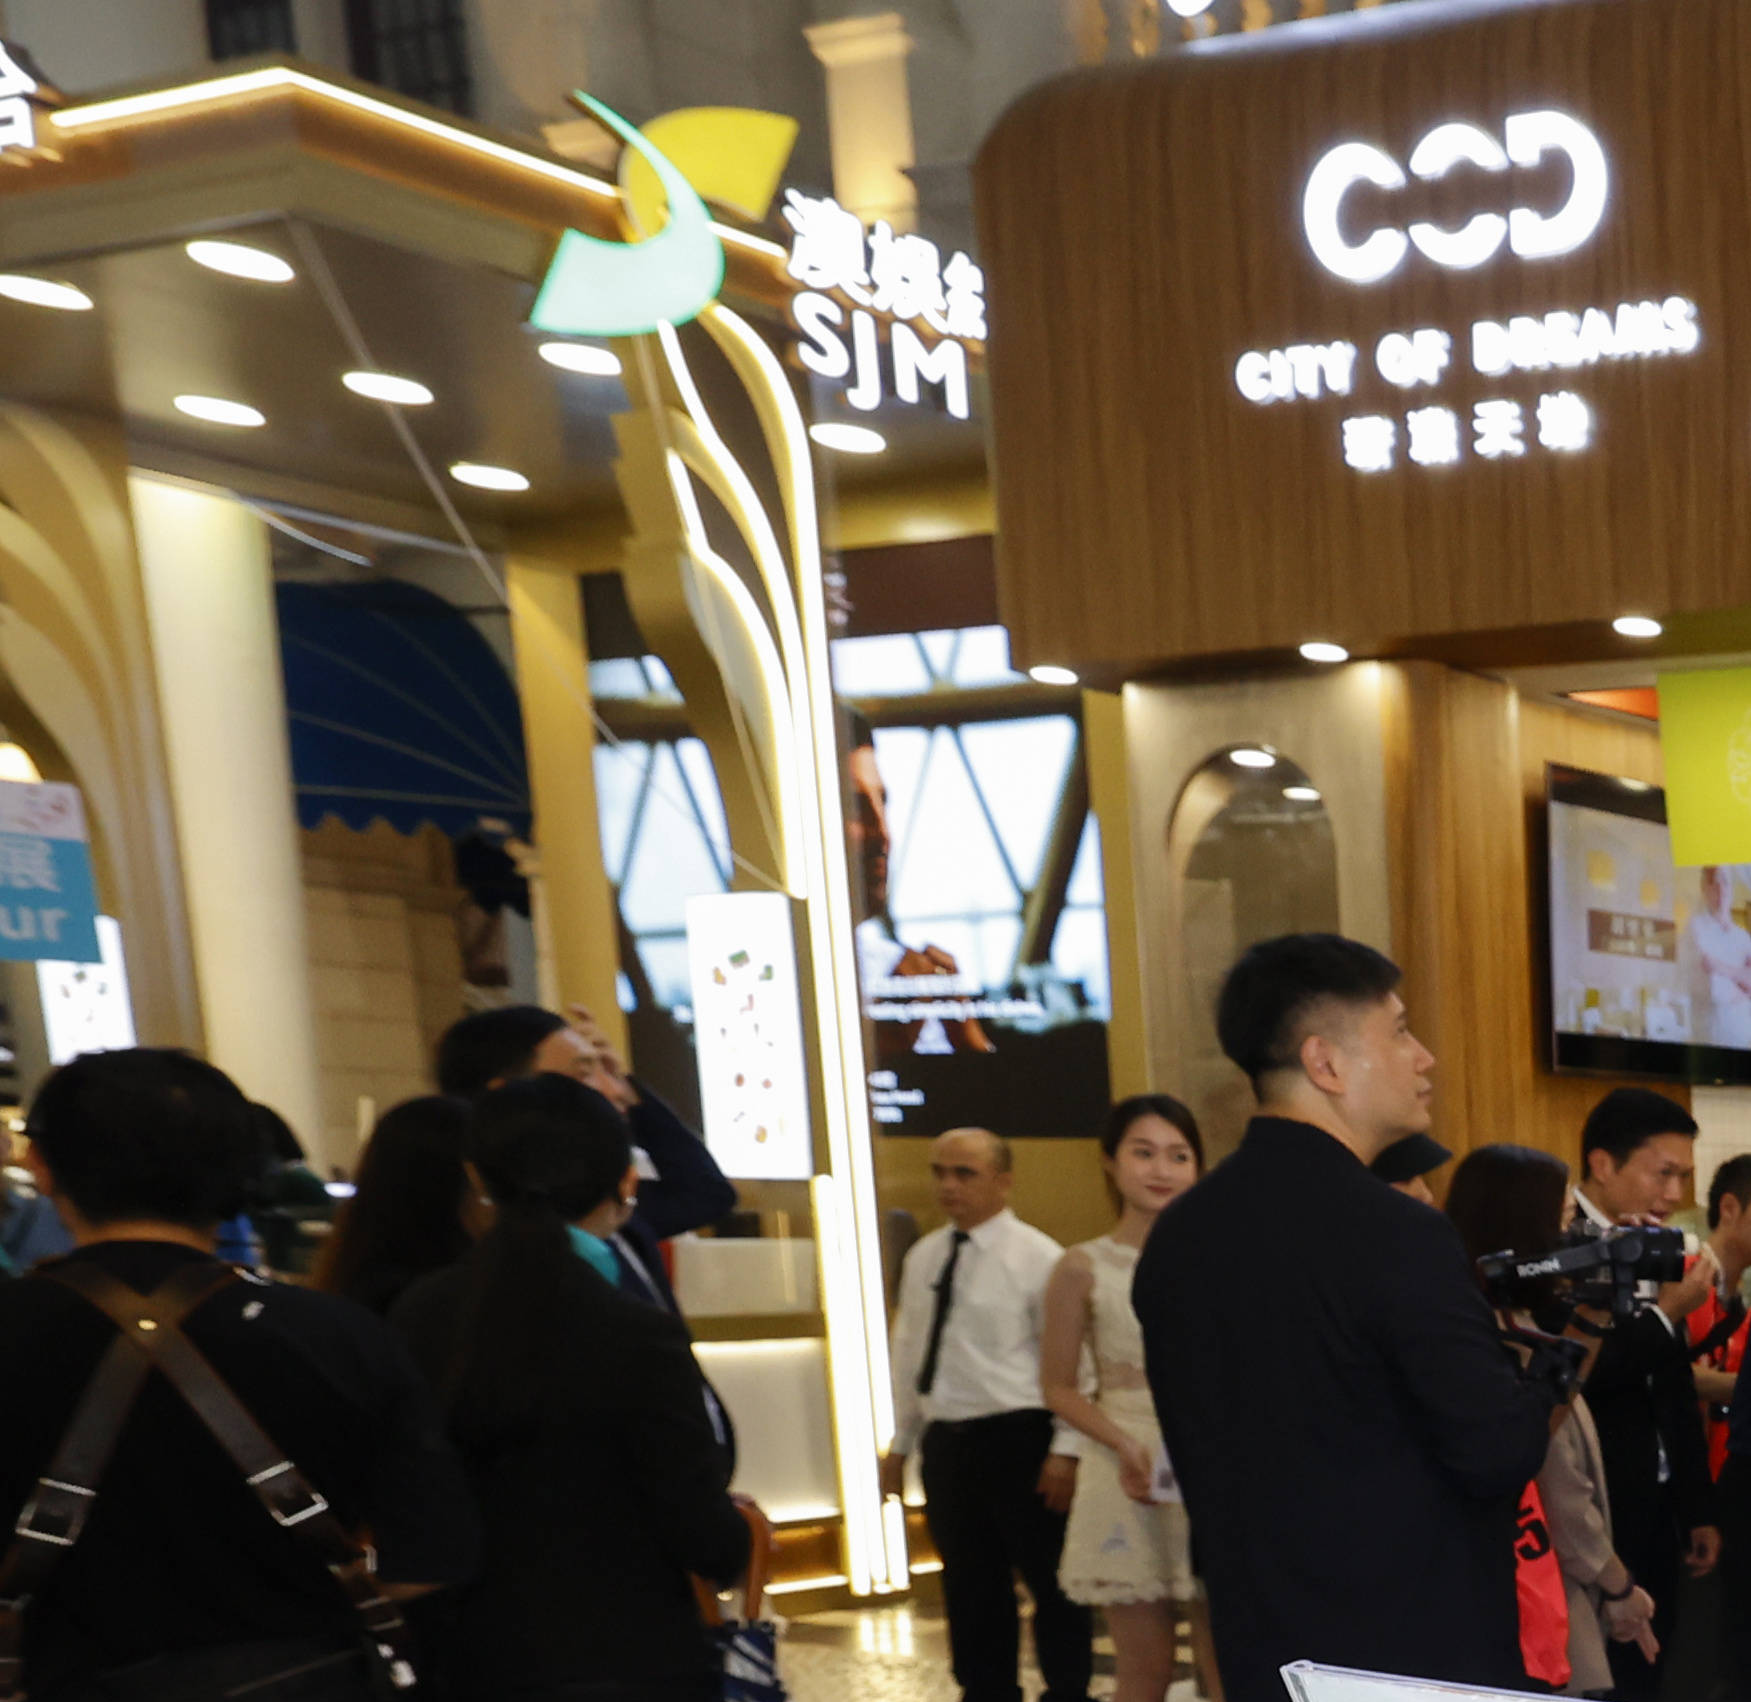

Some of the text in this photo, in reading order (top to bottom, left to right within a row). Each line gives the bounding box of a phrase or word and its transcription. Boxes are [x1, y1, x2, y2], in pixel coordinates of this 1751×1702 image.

[792, 290, 969, 419] SJM
[1236, 296, 1698, 403] CITY OF DREAMS
